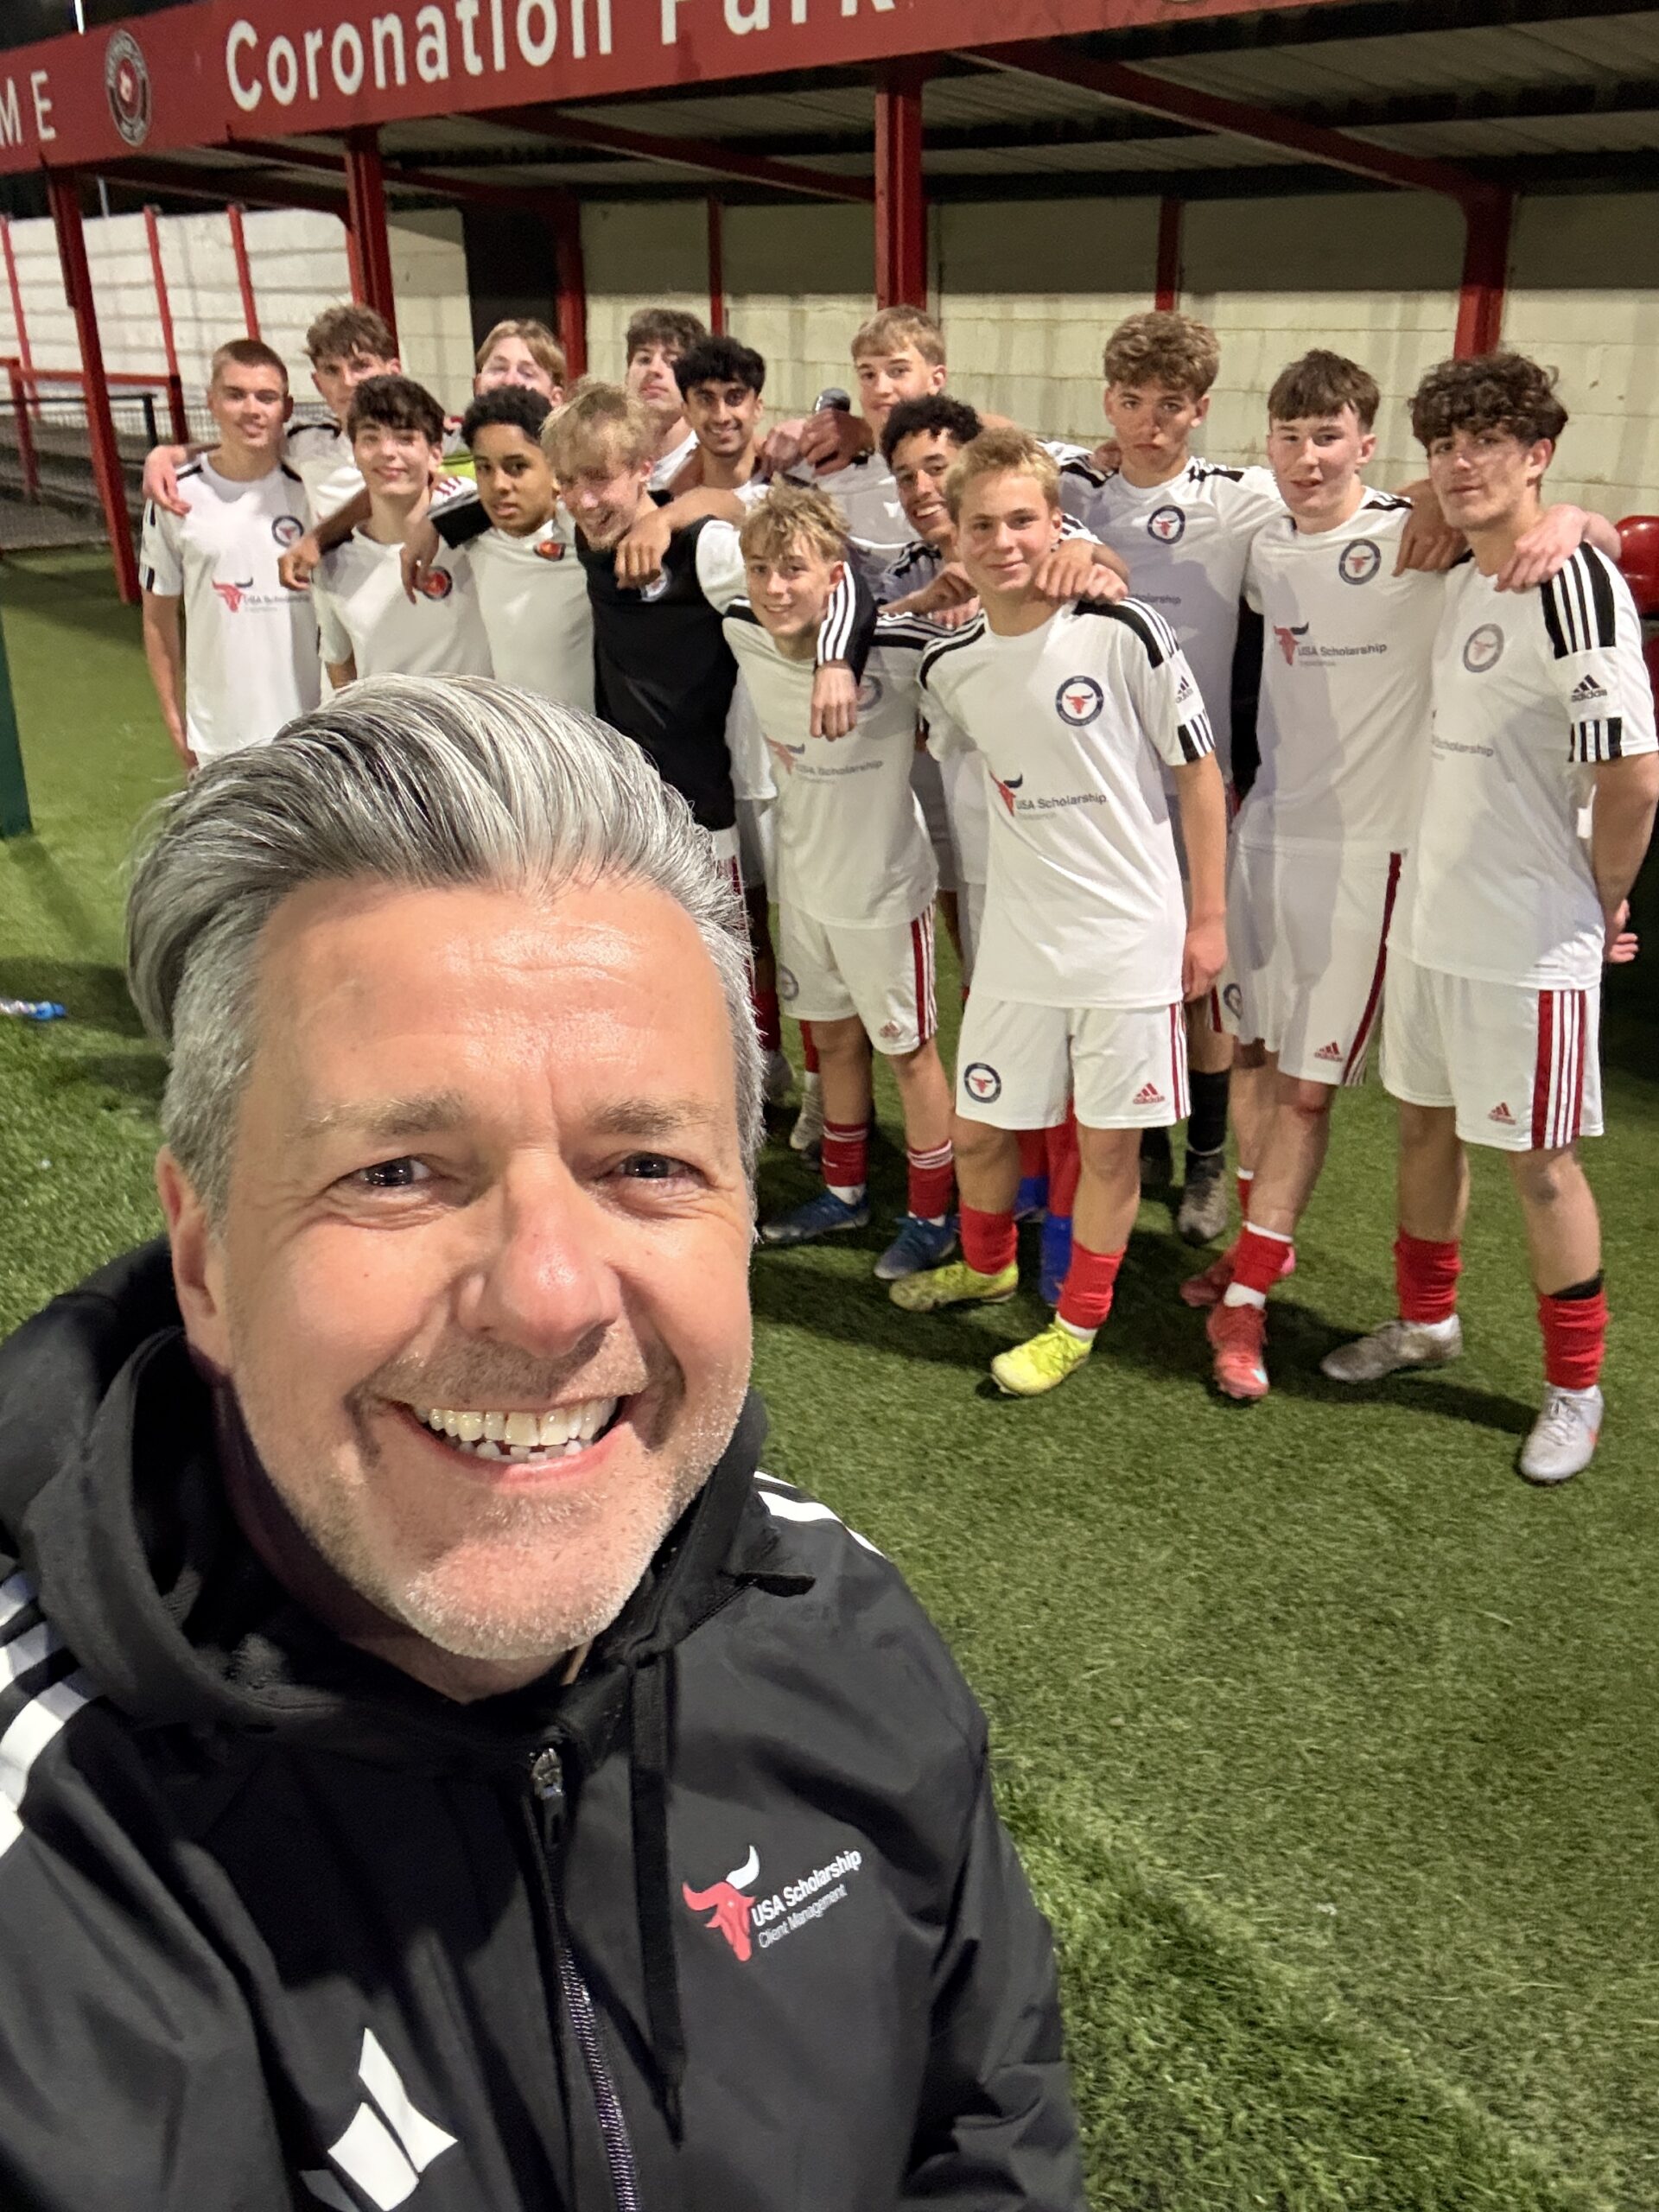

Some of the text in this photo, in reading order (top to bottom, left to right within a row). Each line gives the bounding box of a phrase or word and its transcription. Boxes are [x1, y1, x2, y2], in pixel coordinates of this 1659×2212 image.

[226, 0, 612, 111] Coronation
[1319, 643, 1388, 657] Scholarship
[1038, 792, 1108, 809] Scholarship
[751, 1850, 862, 1927] USA Scholarship
[759, 1884, 848, 1948] Client Management
